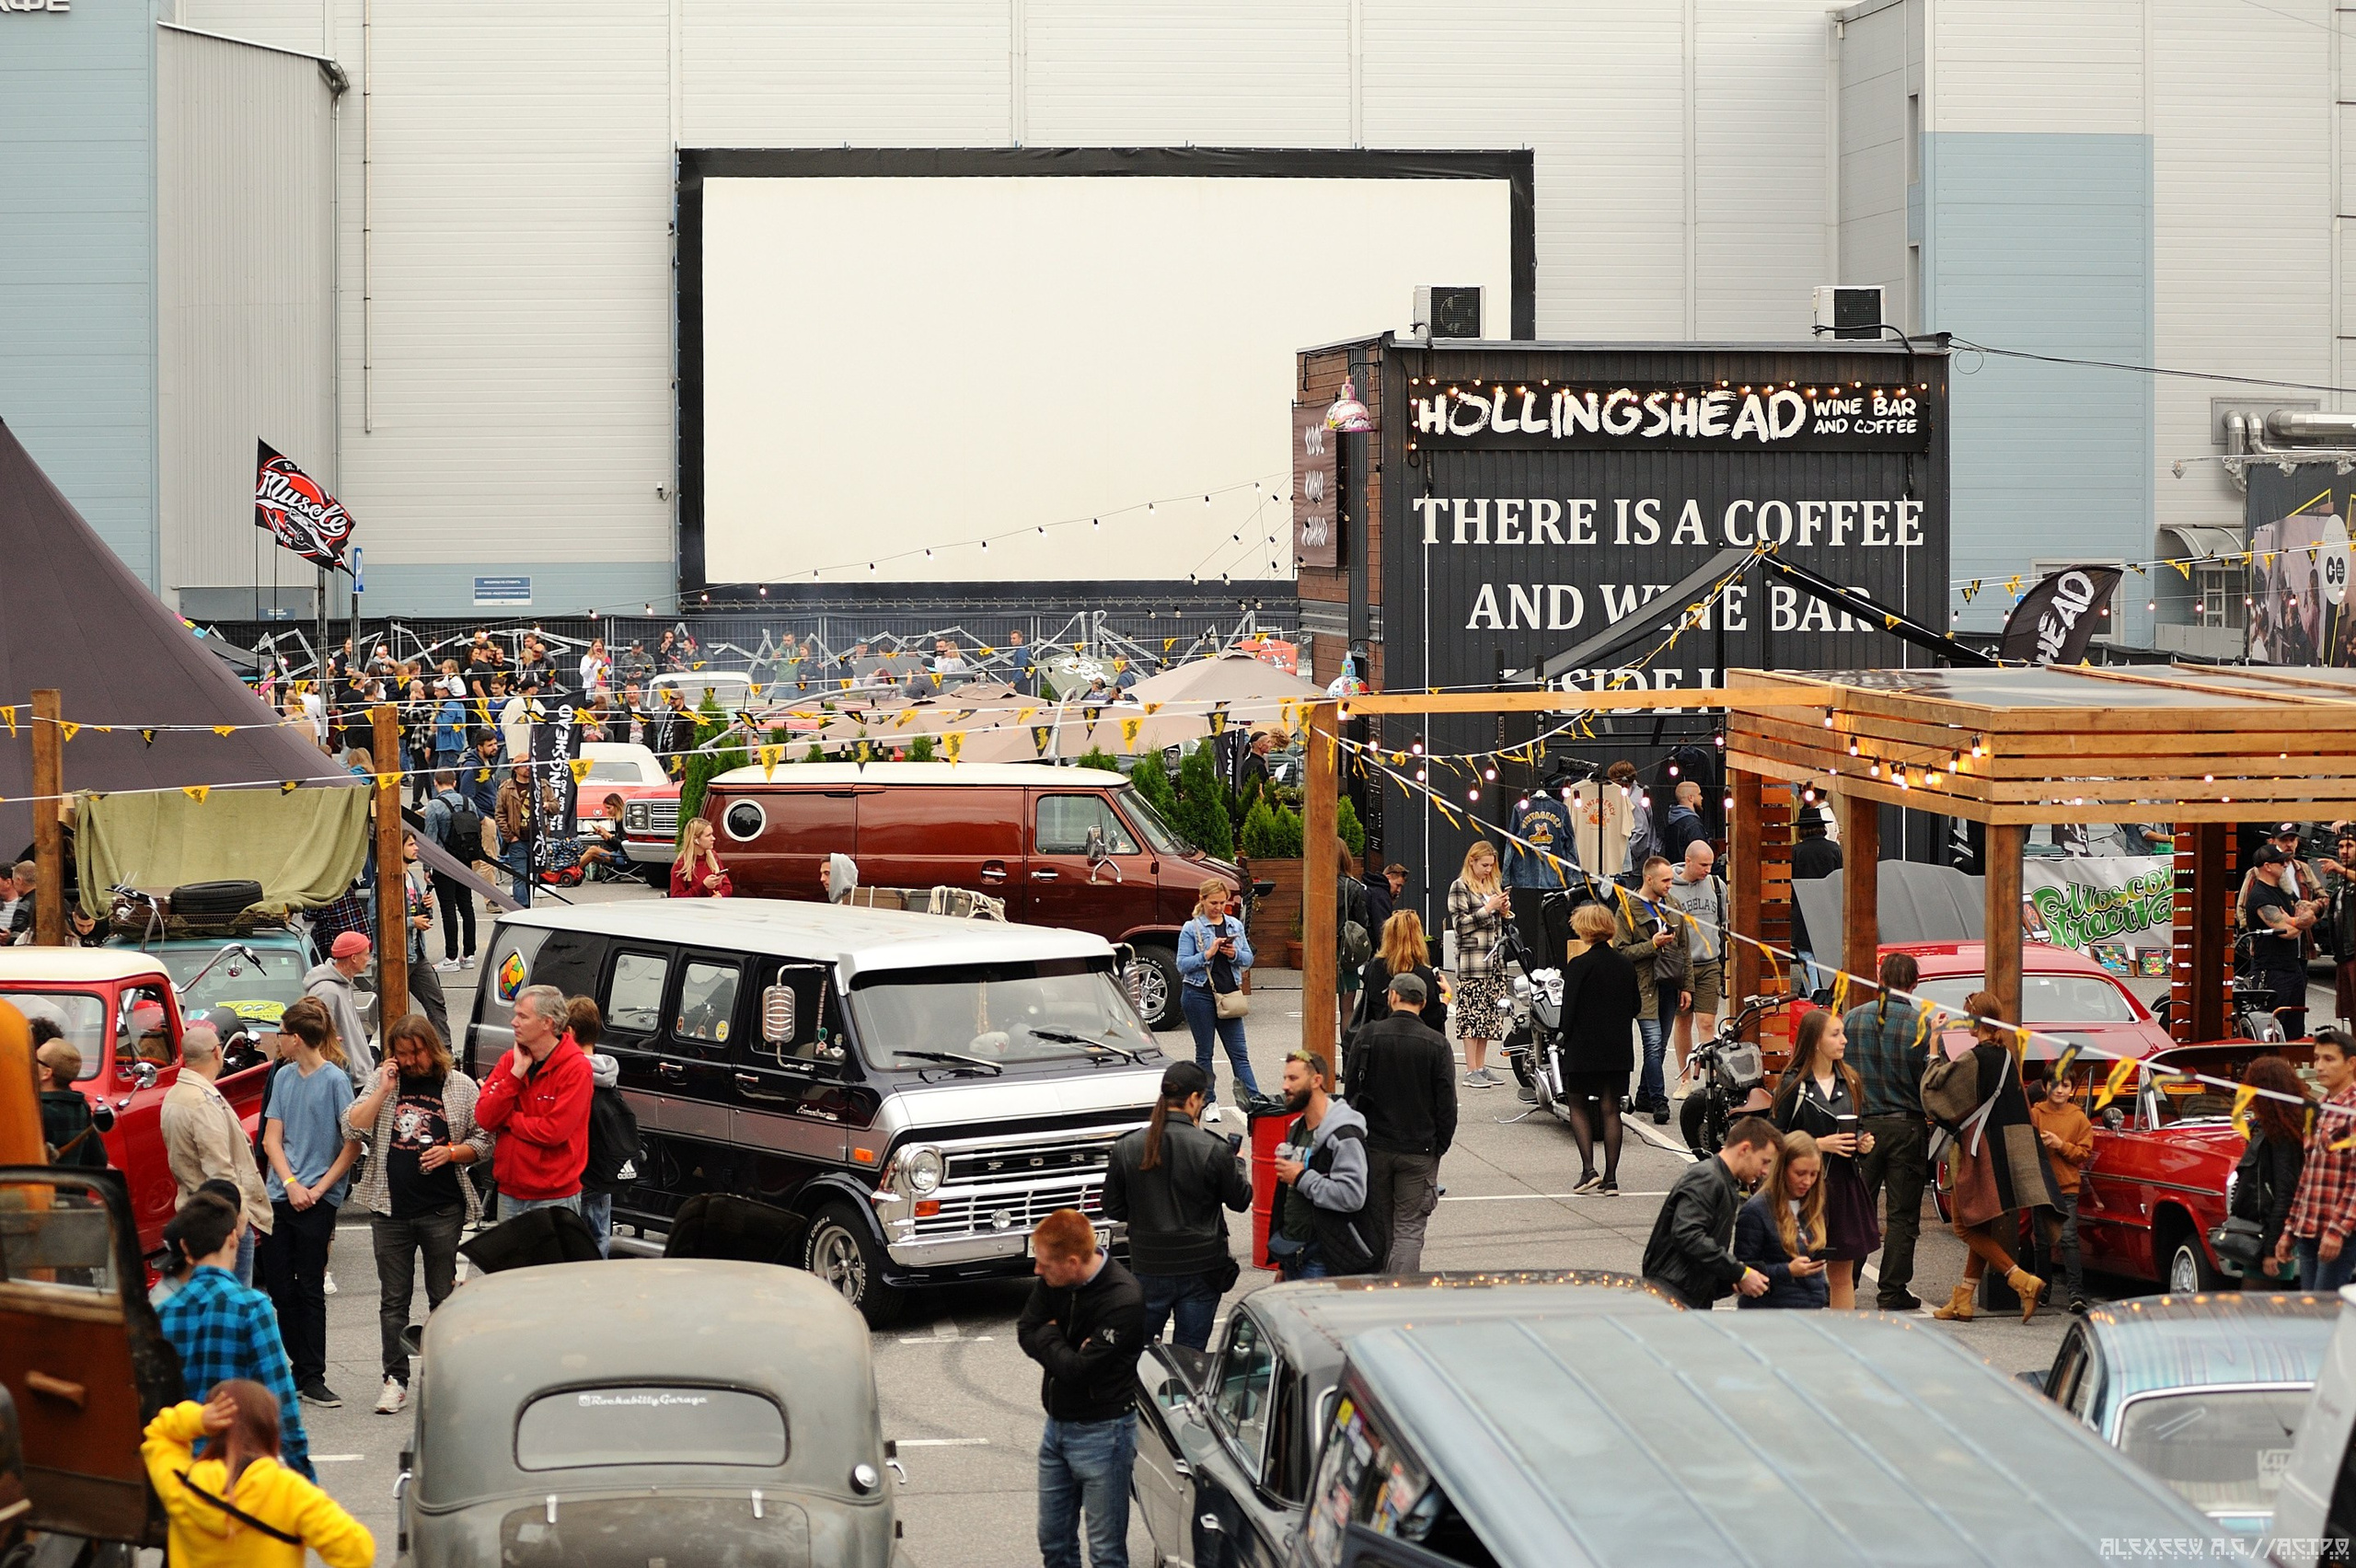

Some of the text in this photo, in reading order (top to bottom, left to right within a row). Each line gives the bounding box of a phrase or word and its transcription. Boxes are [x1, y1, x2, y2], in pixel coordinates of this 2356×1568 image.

[1418, 387, 1917, 444] HOLLINGSHEAD WINE BAR
[1813, 419, 1918, 434] AND COFFEE
[256, 469, 348, 536] Muscle
[1413, 498, 1924, 547] THERE IS A COFFEE
[1466, 584, 1585, 629] AND
[1599, 584, 1748, 631] WNE
[987, 1153, 1085, 1170] FOR
